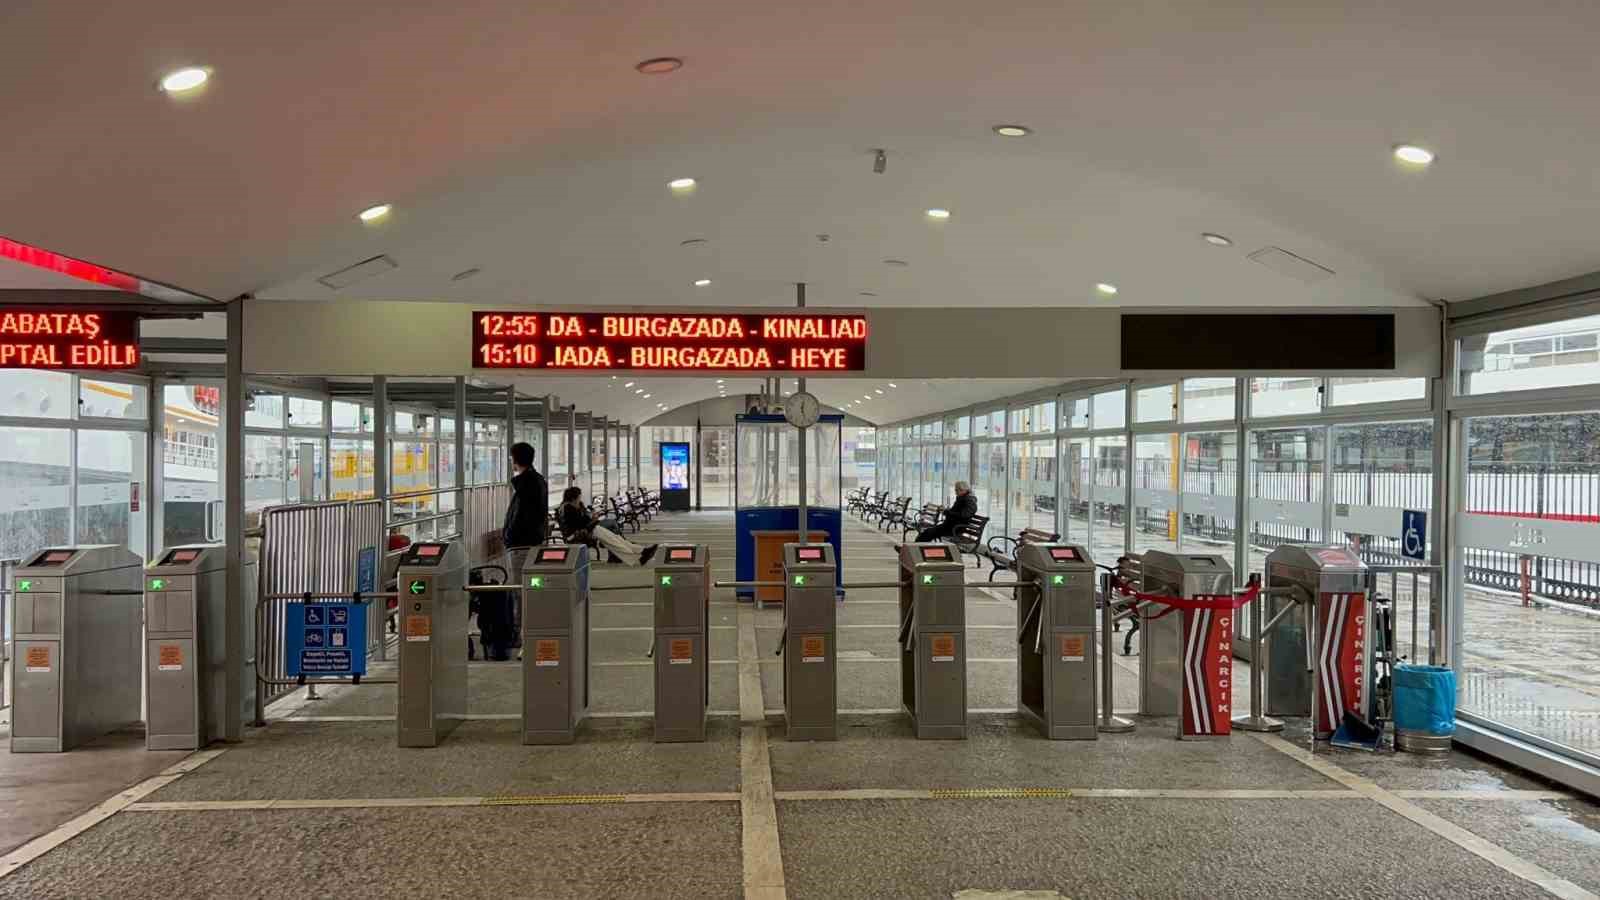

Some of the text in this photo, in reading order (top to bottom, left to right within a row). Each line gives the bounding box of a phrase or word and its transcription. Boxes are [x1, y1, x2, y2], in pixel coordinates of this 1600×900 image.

[0, 313, 101, 339] ABATAŞ
[480, 315, 537, 336] 12:55
[546, 316, 583, 337] DA
[602, 316, 744, 338] BURGAZADA
[763, 318, 866, 339] KINALIAD
[0, 344, 63, 365] PTAL
[480, 344, 537, 364] 15:10
[546, 346, 611, 367] IADA
[631, 346, 771, 368] BURGAZADA
[791, 348, 847, 368] HEYE
